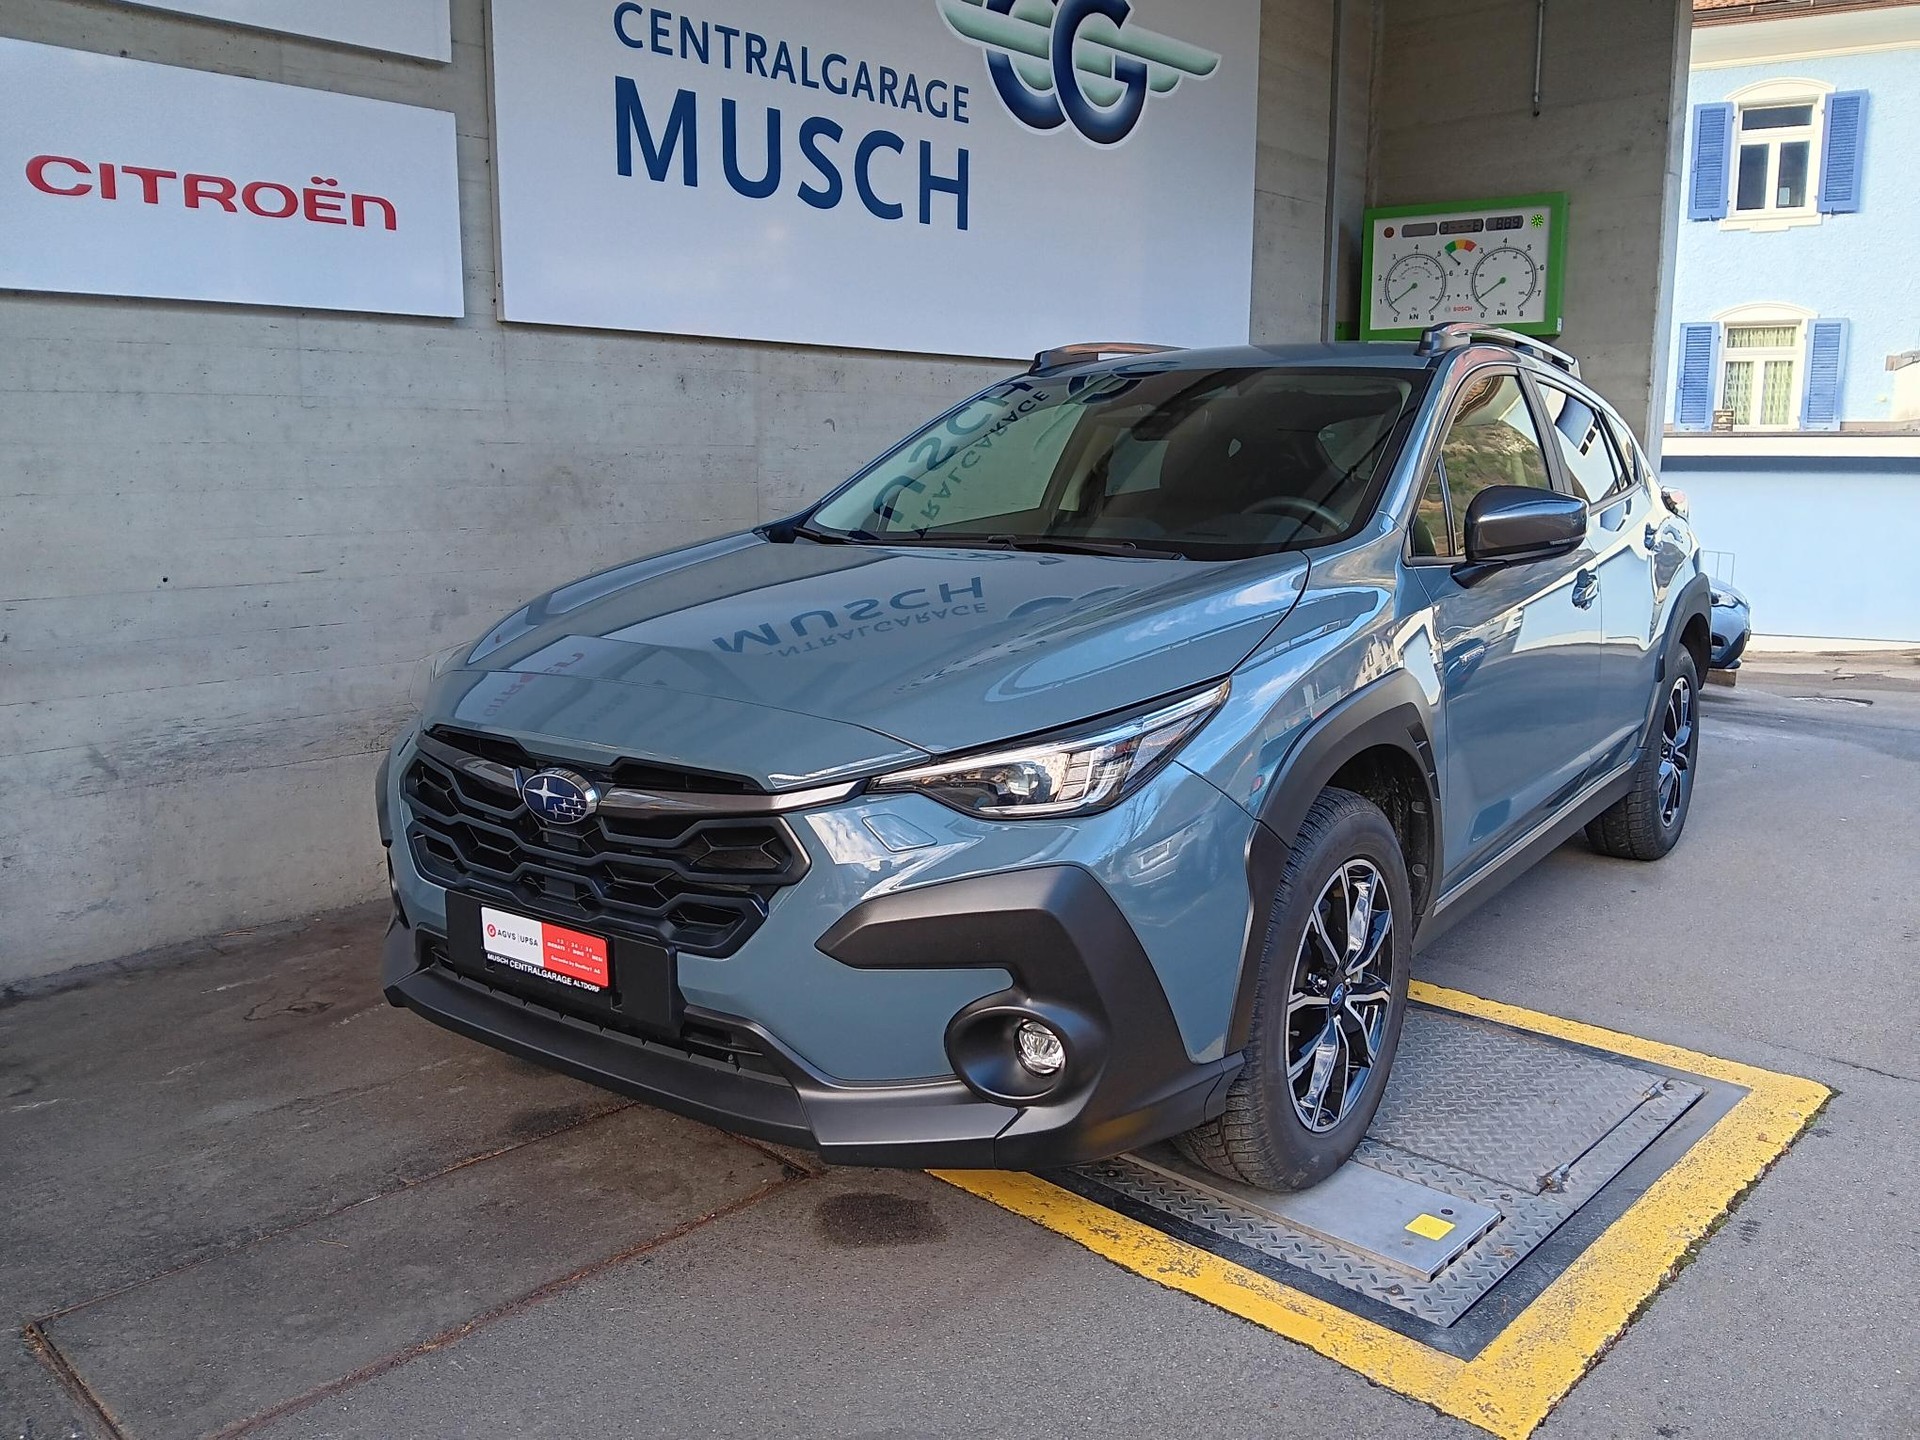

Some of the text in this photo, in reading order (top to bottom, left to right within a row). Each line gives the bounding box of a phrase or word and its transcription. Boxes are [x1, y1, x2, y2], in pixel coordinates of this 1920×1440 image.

[613, 2, 969, 124] CENTRALGARAGE
[615, 76, 969, 231] MUSCH
[487, 953, 600, 993] MUSCH CENTRALGARAGE ALTDORF
[497, 929, 538, 947] AGVS UPSA
